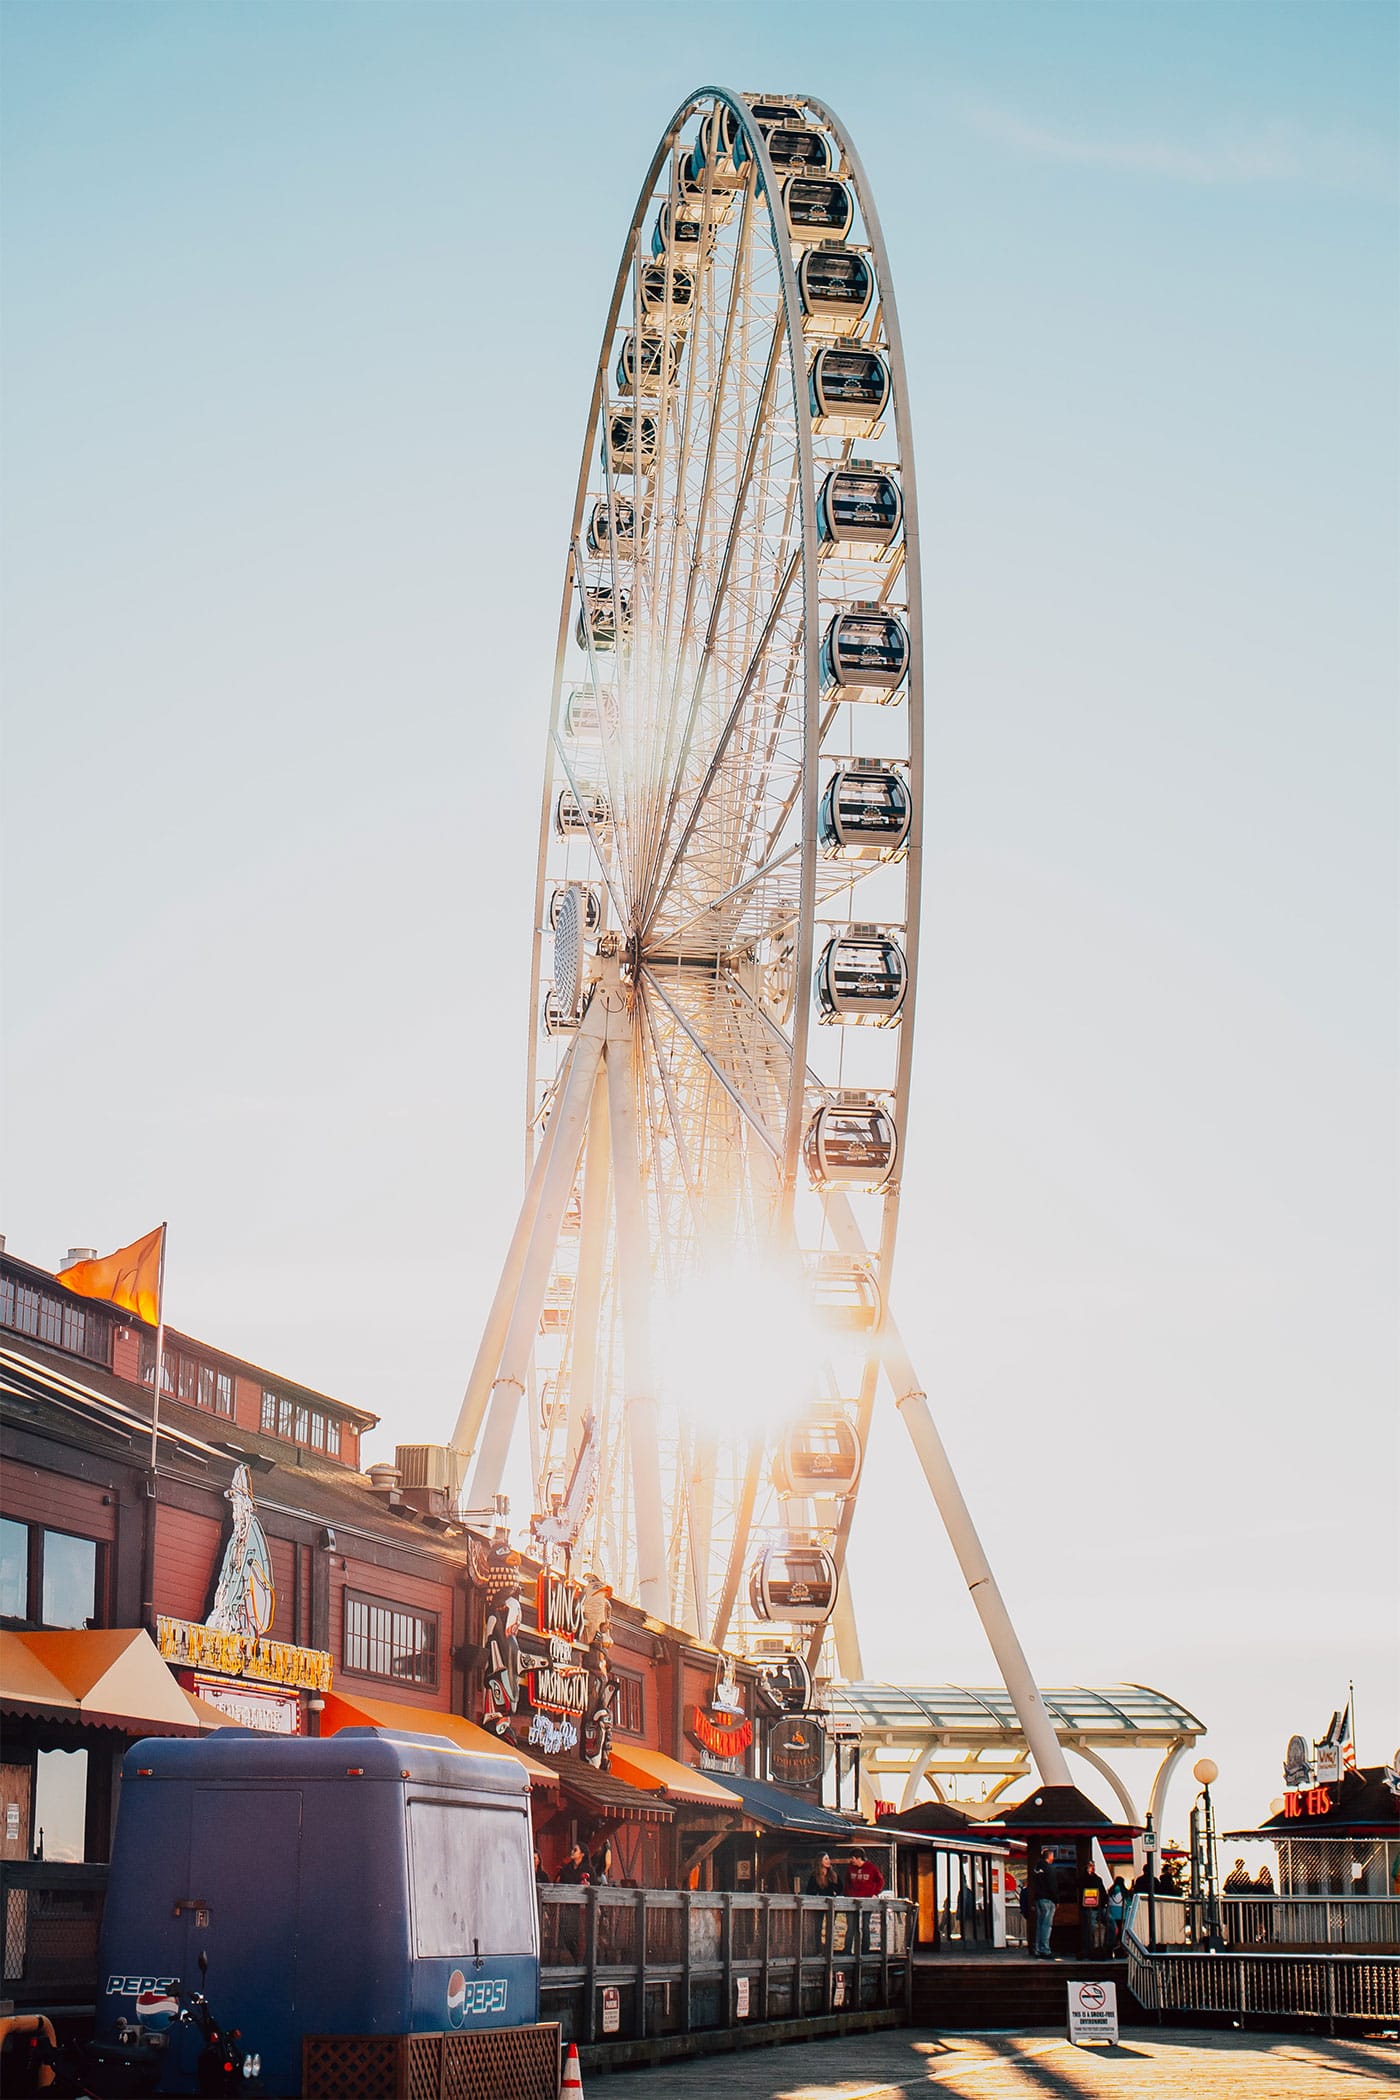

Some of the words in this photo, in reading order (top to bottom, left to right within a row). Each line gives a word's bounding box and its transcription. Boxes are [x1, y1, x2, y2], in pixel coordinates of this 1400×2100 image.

[538, 1669, 589, 1712] WASHINGTON
[1283, 1787, 1330, 1818] TICETS
[106, 1976, 180, 1996] PEPS
[463, 1980, 507, 2015] PEPSI
